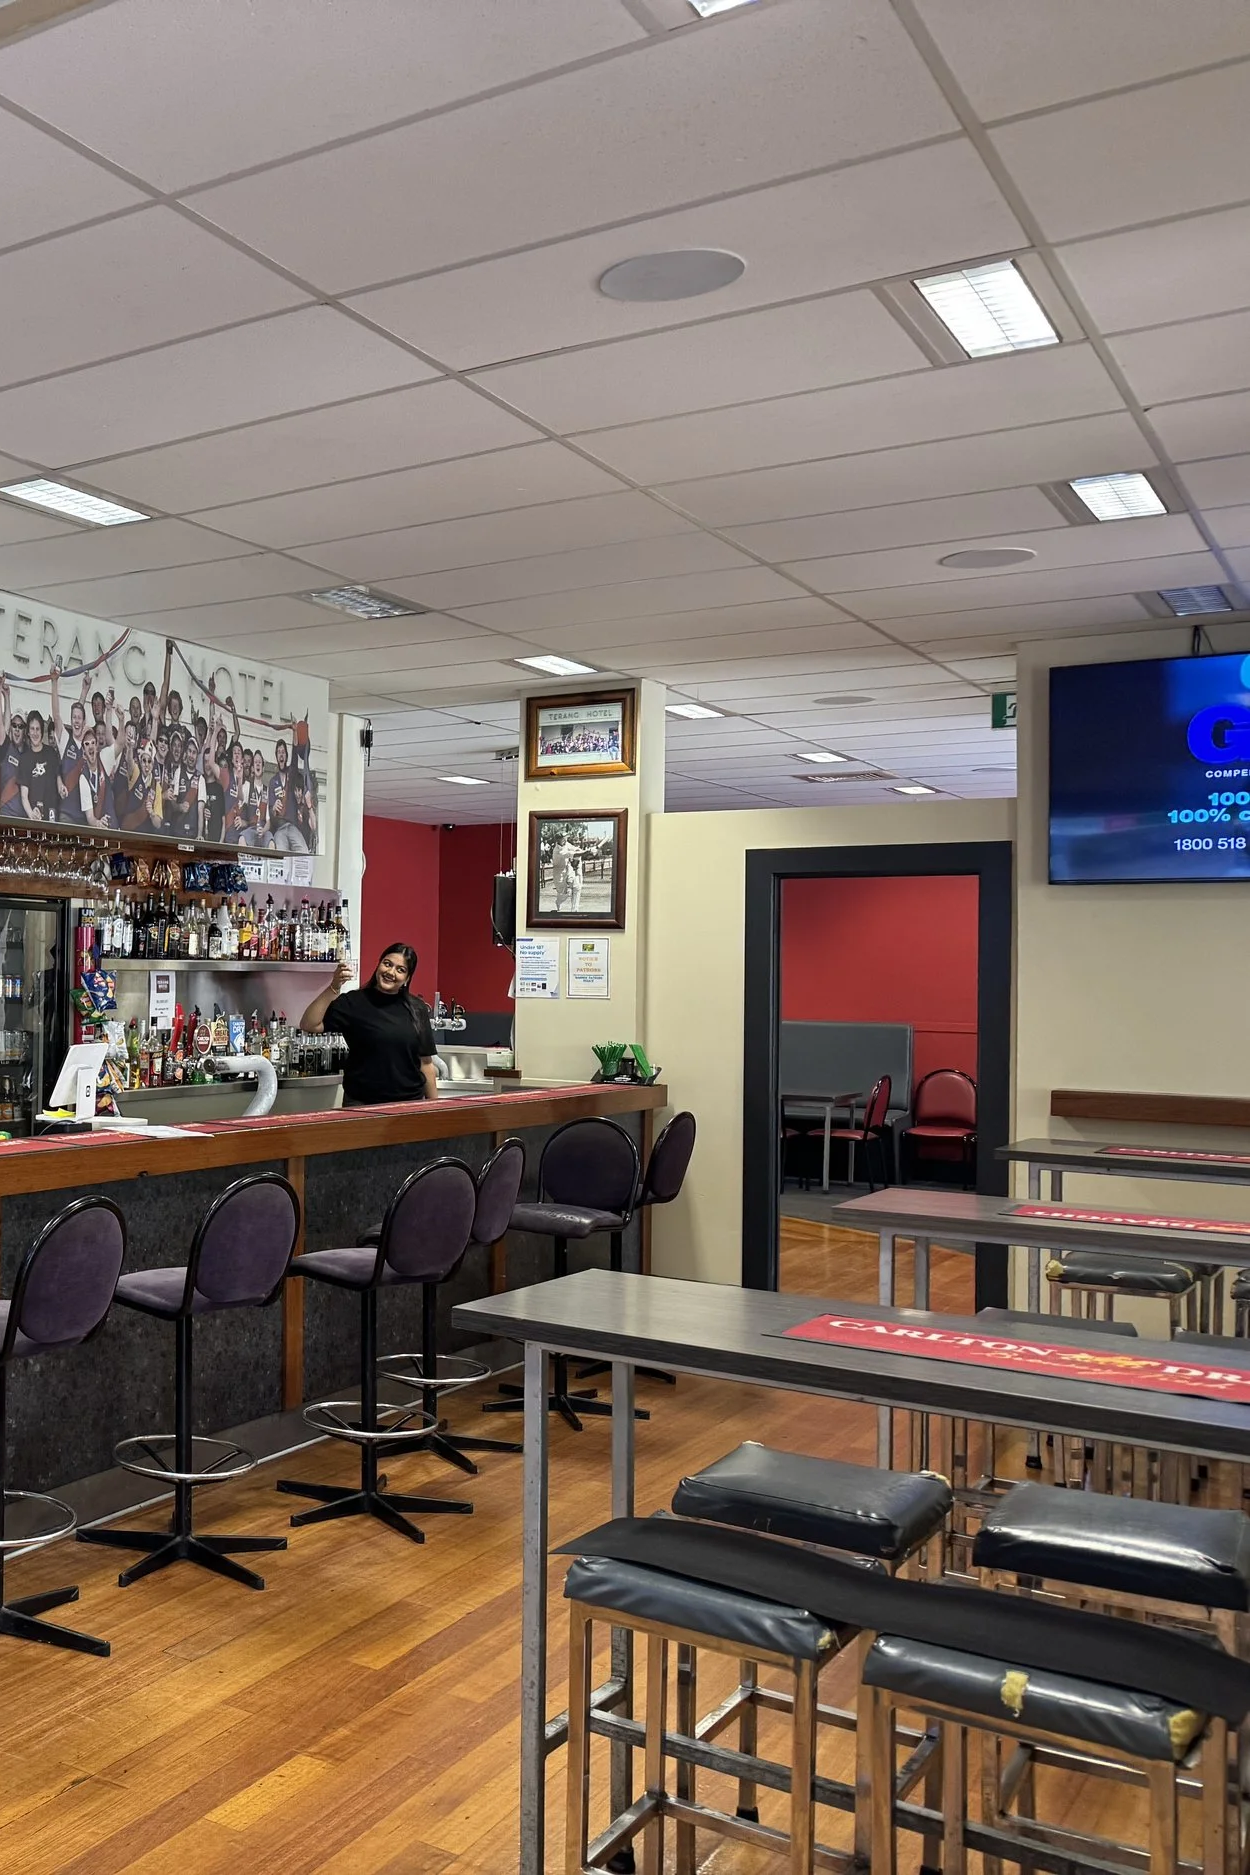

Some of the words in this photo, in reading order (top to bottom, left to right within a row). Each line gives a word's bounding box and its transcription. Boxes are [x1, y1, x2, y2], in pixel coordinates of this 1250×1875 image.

[188, 655, 293, 722] HOTEL
[548, 711, 580, 720] TERANG
[587, 709, 612, 717] HOTEL
[1167, 808, 1231, 824] 100%
[1173, 838, 1213, 851] 1800
[1217, 837, 1247, 850] 518
[232, 1025, 245, 1033] DRY
[829, 1320, 1054, 1356] CARLTON
[1161, 1365, 1250, 1385] DR
